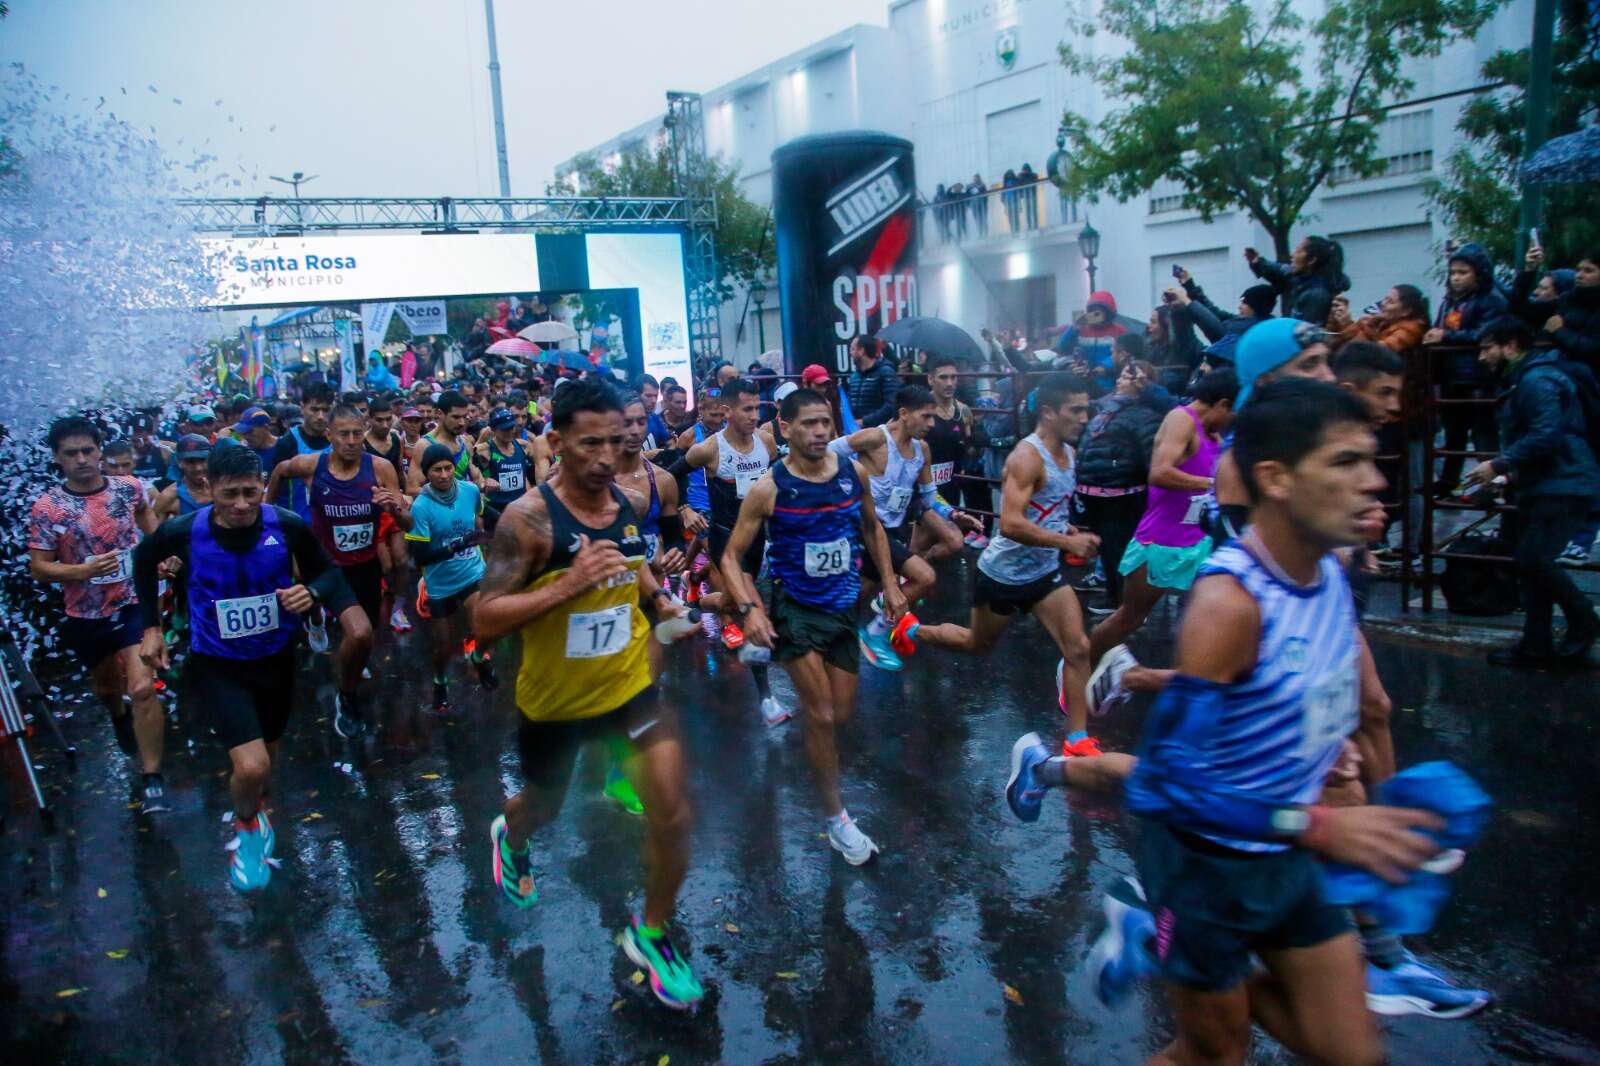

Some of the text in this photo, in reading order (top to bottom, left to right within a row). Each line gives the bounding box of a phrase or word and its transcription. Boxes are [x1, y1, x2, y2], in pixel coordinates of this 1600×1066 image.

[830, 172, 900, 235] LIDER
[236, 254, 357, 273] Santa Rosa
[250, 274, 344, 288] MUNICIPIO
[506, 475, 518, 488] 19
[324, 503, 371, 518] ATLETISMO
[337, 530, 370, 548] 249
[226, 605, 272, 633] 603
[587, 619, 617, 650] 17
